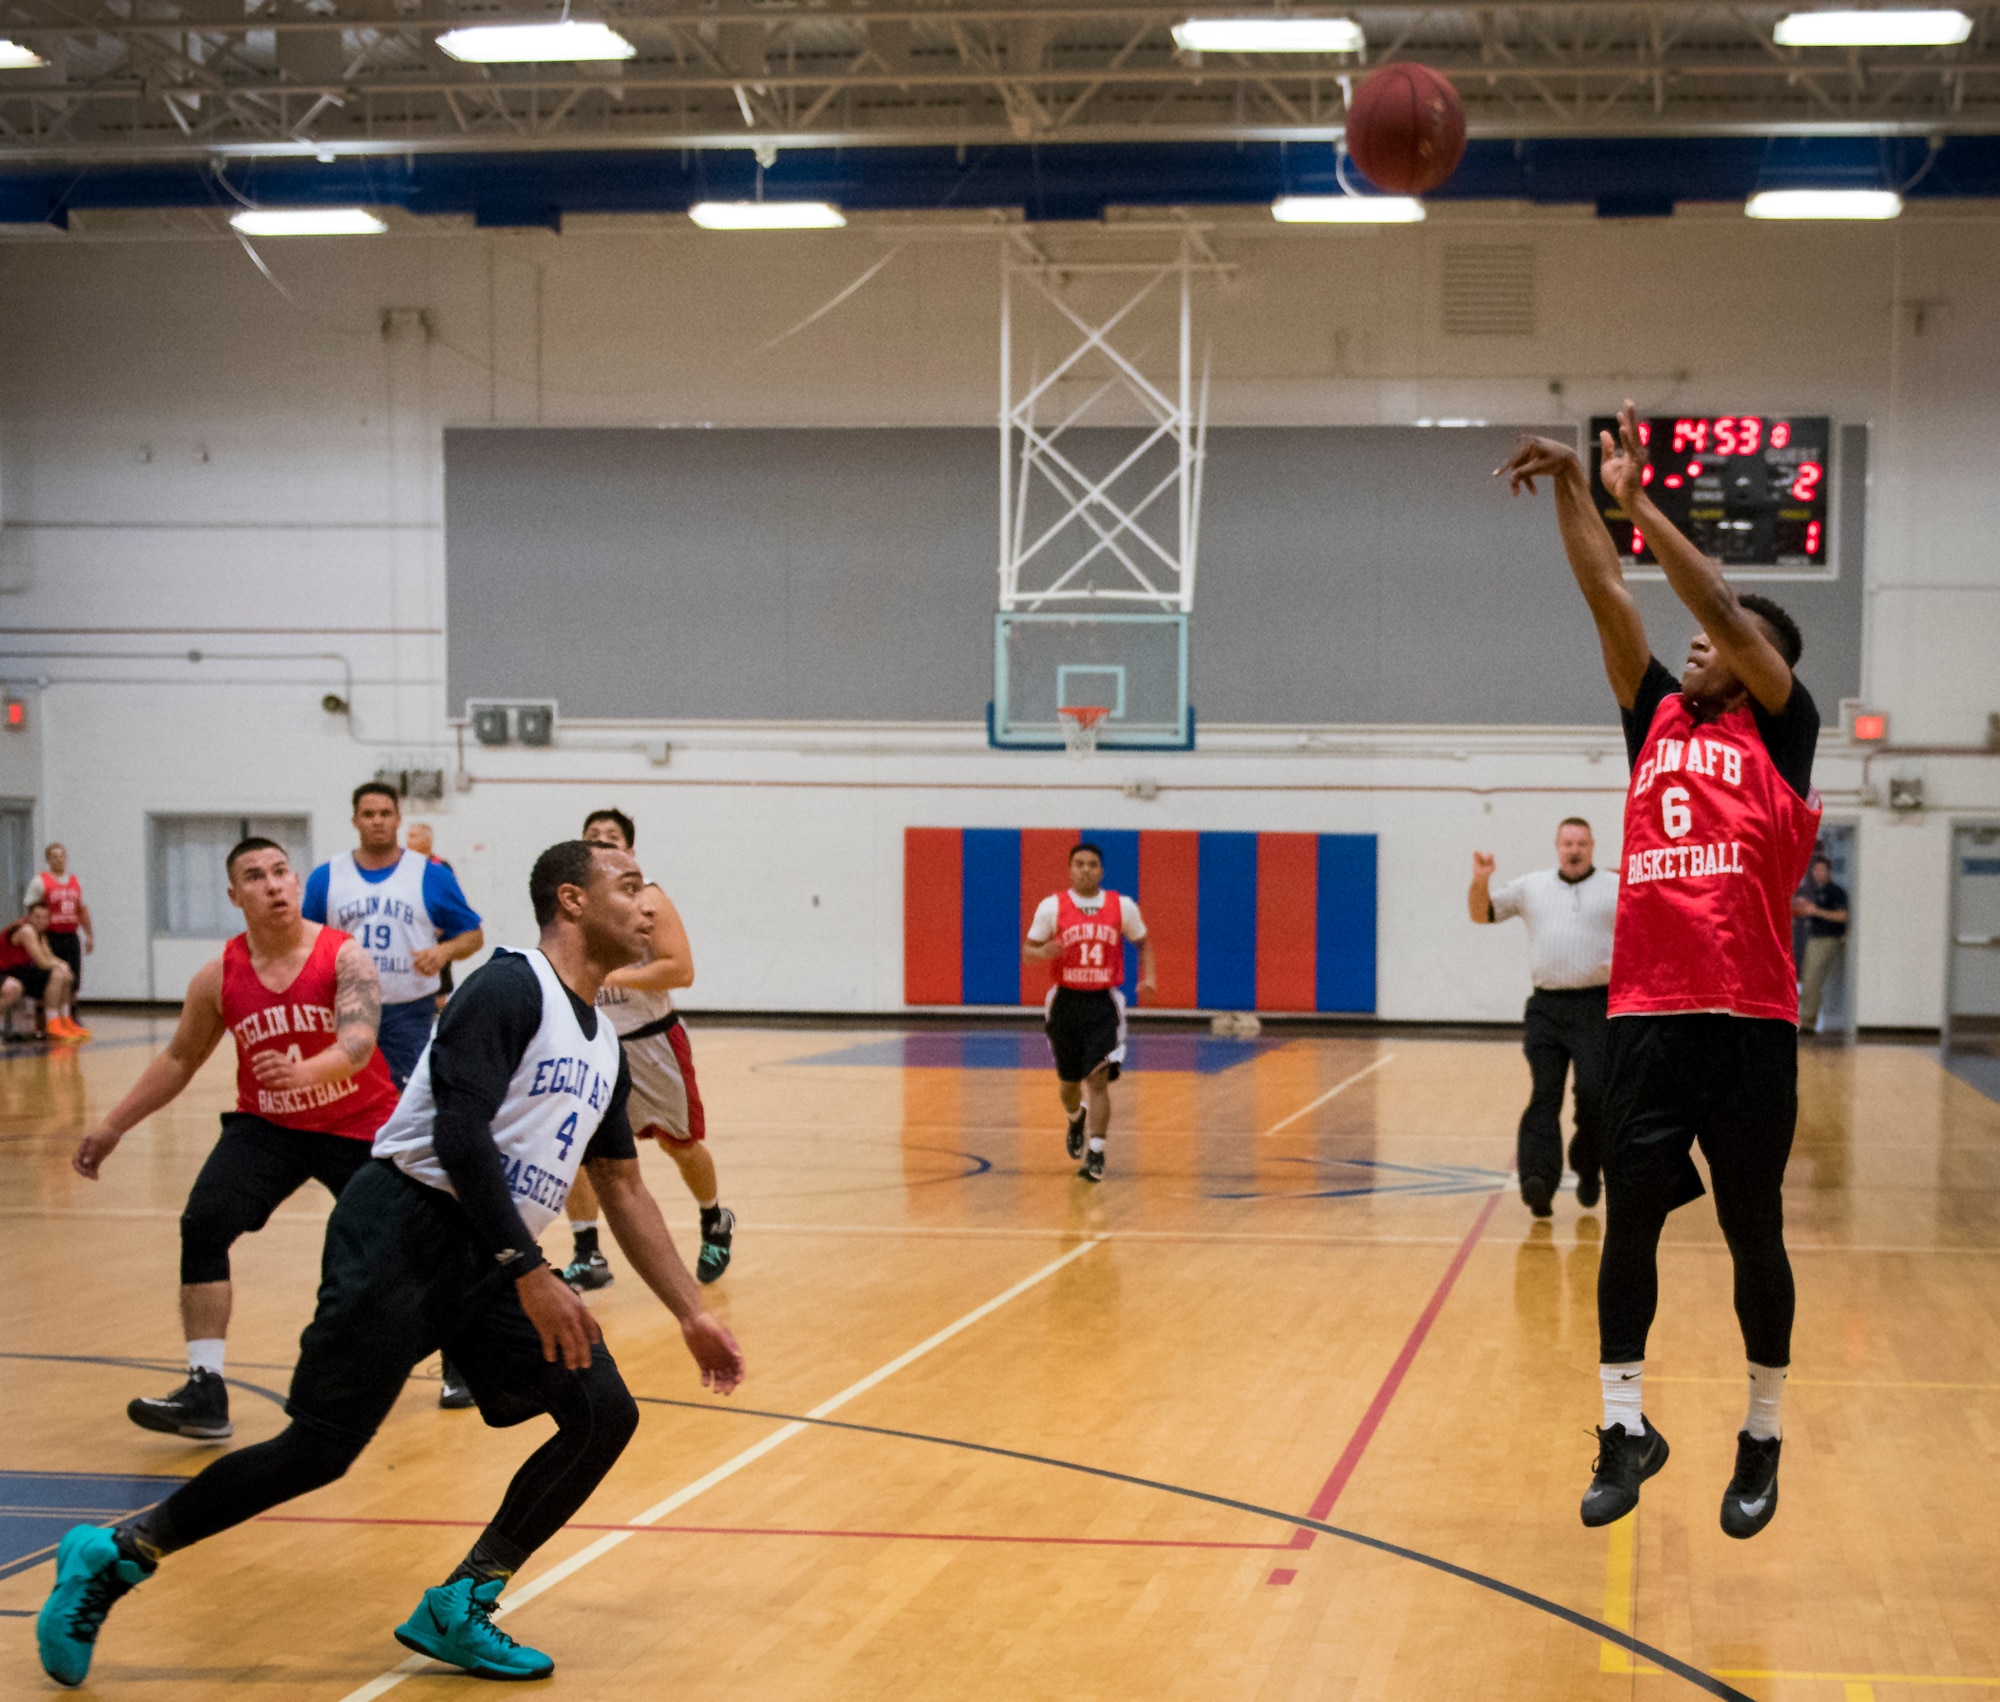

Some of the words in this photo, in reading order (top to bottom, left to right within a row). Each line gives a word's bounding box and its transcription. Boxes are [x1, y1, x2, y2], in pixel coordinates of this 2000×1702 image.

[1685, 737, 1741, 785] AFB
[1661, 786, 1692, 839] 6
[1627, 842, 1743, 885] BASKETBALL
[363, 924, 391, 950] 19
[1080, 943, 1103, 966] 14
[293, 1004, 336, 1033] AFB
[258, 1075, 360, 1114] BASKETBALL
[556, 1111, 578, 1161] 4
